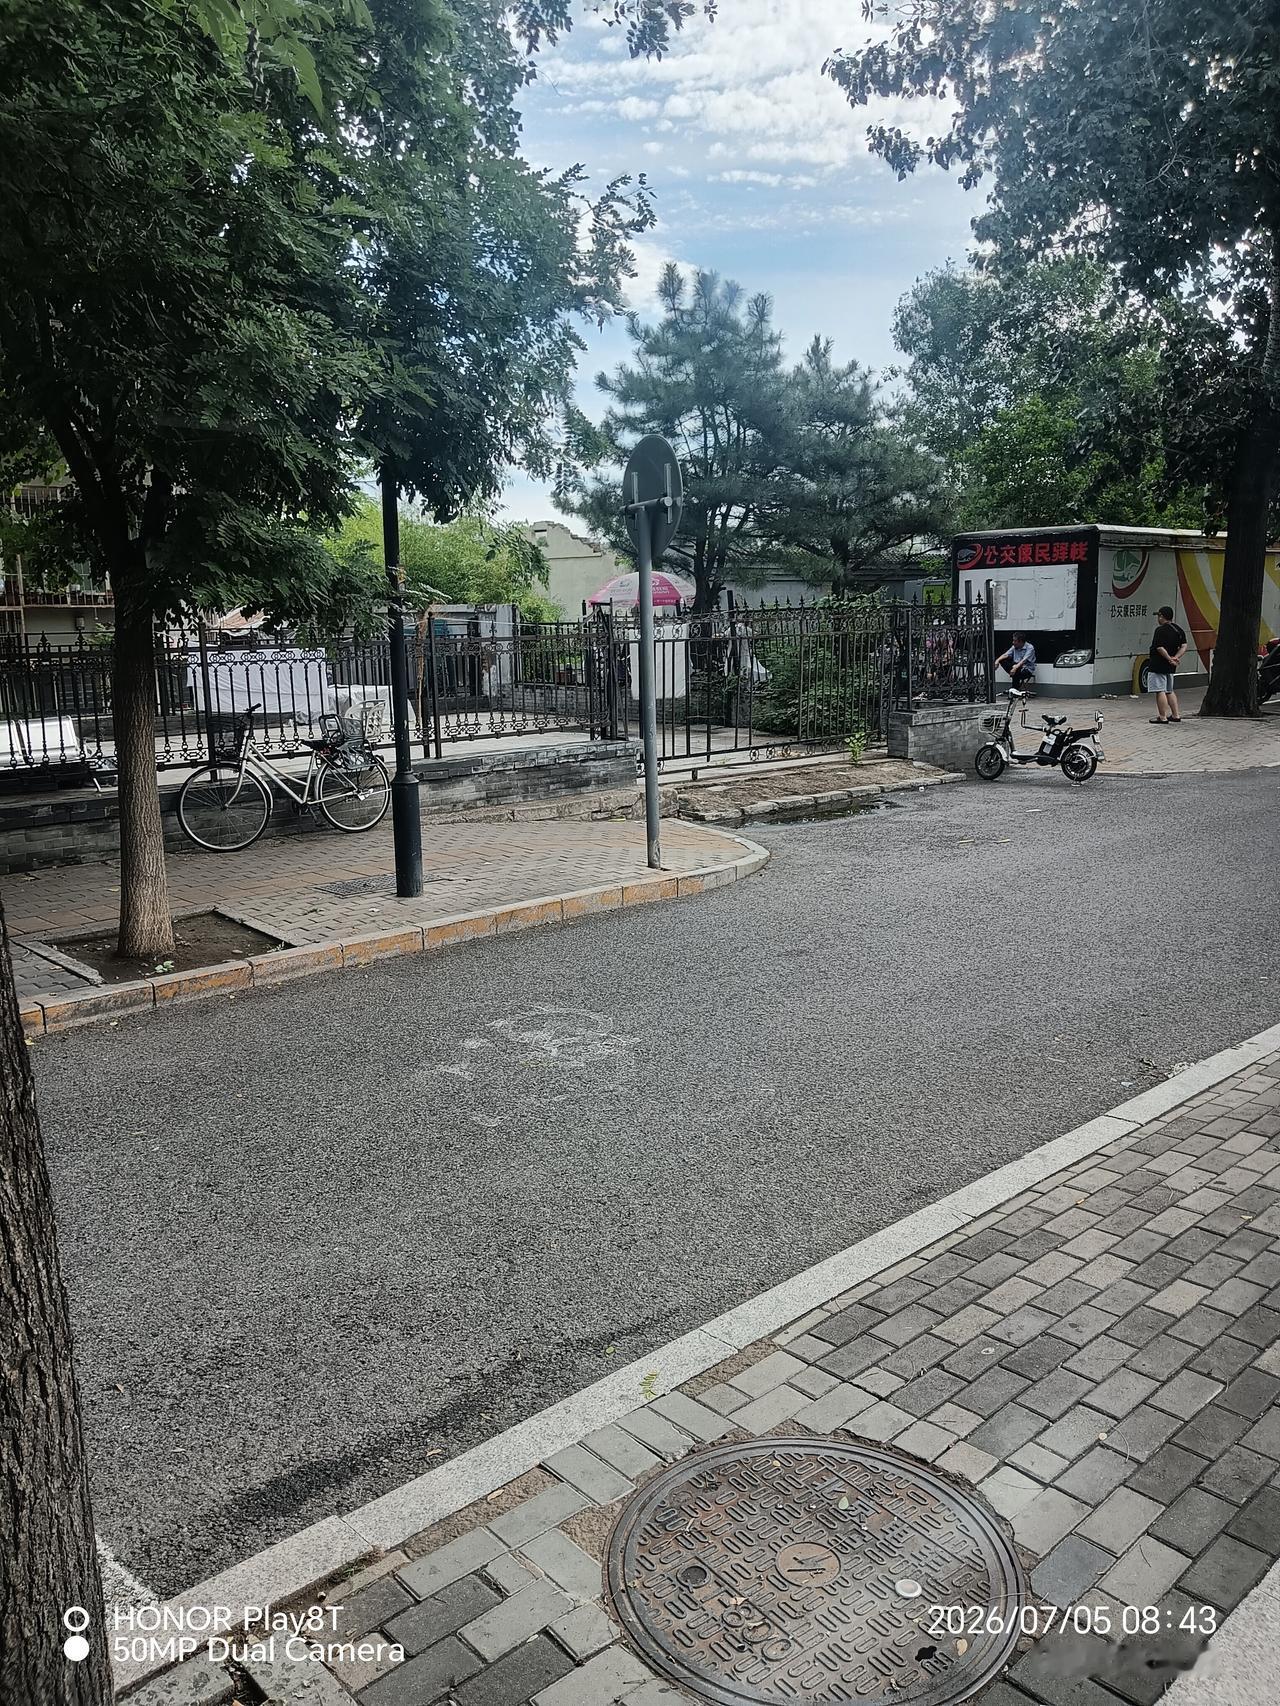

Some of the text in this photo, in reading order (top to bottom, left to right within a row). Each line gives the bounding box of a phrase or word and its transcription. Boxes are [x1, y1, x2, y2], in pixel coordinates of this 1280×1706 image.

[983, 541, 1089, 565] 公交便民驿栈
